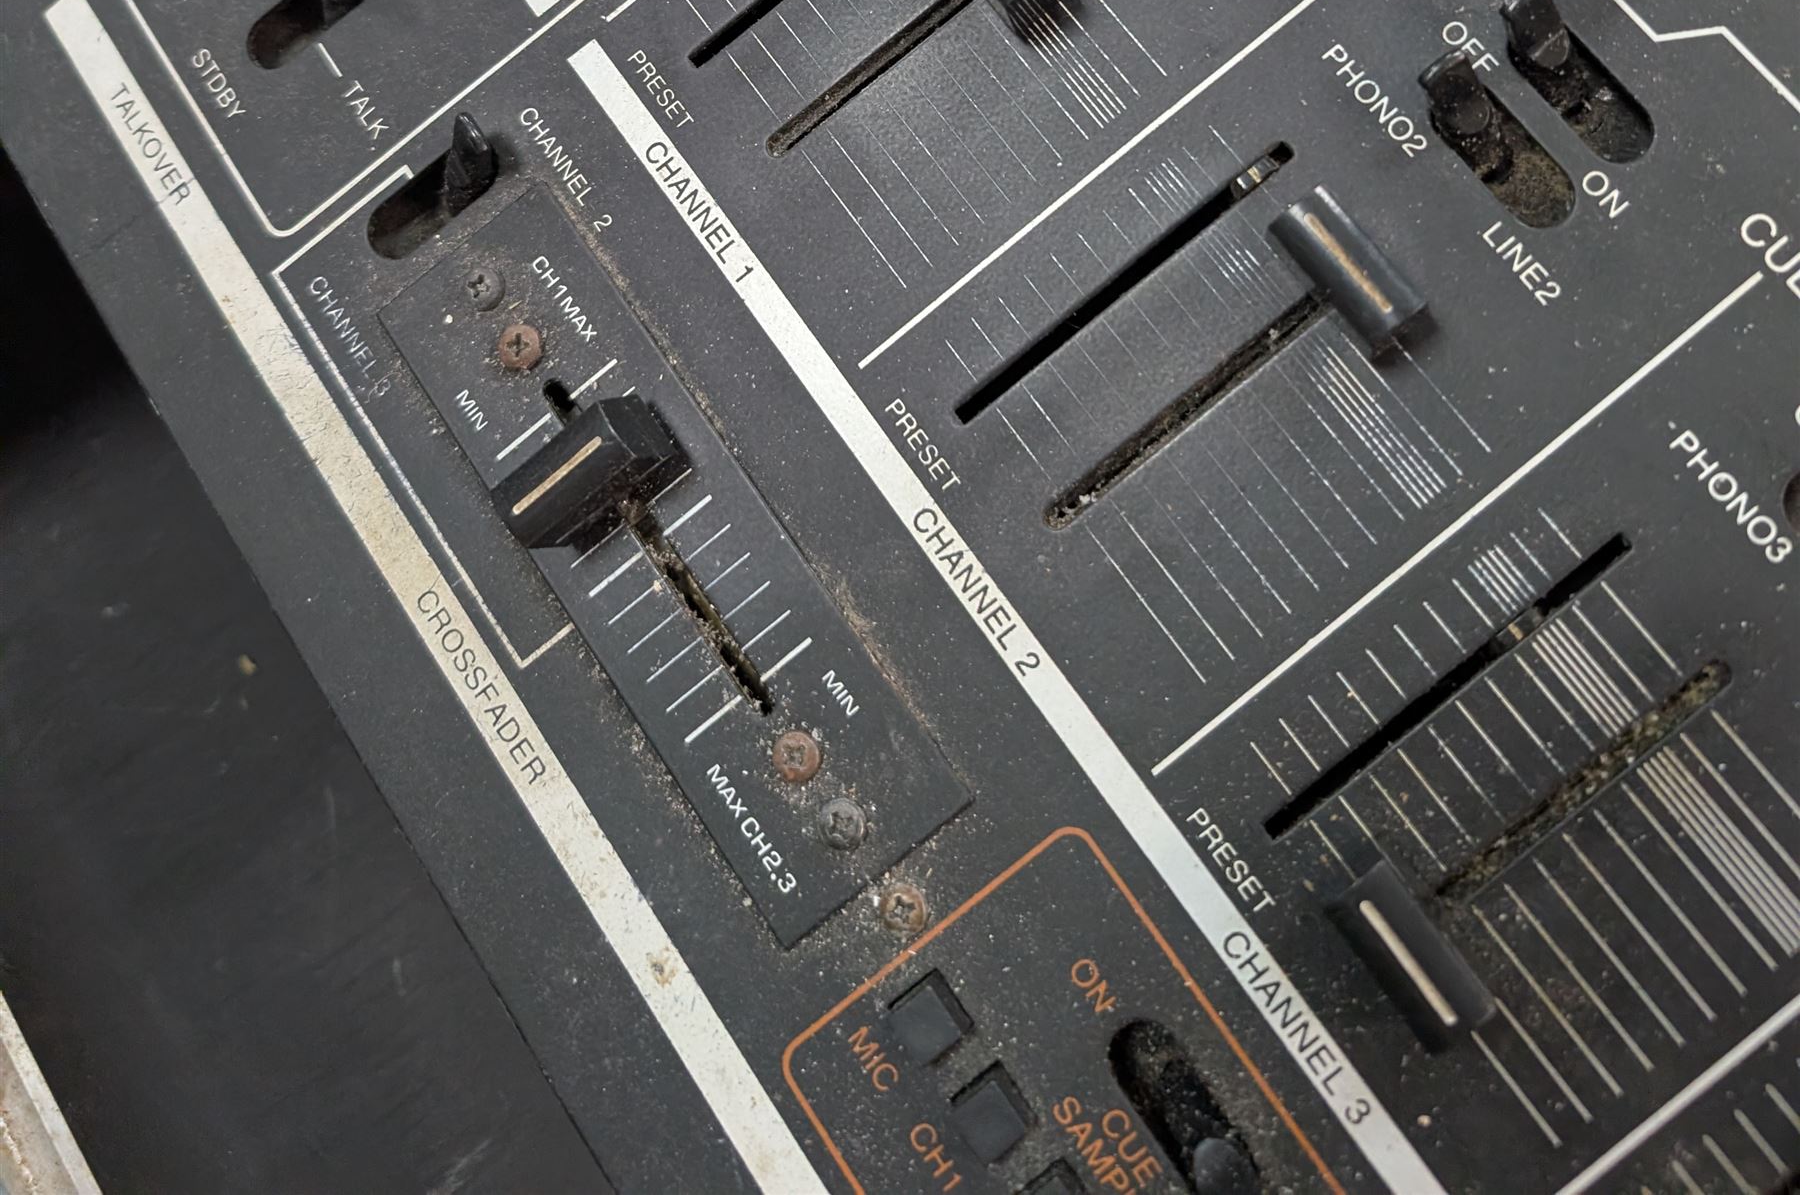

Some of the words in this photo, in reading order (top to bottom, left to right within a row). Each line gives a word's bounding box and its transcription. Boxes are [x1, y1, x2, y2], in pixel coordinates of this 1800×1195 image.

[191, 47, 247, 119] STDBY
[627, 50, 695, 130] PRESET
[1442, 21, 1499, 76] OFF
[109, 82, 191, 206] TALKOVER
[341, 80, 391, 141] TALK
[1321, 43, 1428, 158] PHONO2
[520, 107, 595, 206] CHANNEL
[593, 214, 613, 232] 2
[645, 141, 734, 266] CHANNEL
[735, 265, 756, 285] 1
[1582, 170, 1629, 220] ON
[1482, 220, 1562, 306] LINE2
[309, 276, 377, 377] CHANNEL
[374, 381, 391, 397] 3
[455, 389, 488, 431] MIN
[884, 398, 962, 491] PRESET
[1669, 429, 1793, 564] PHONO3
[912, 508, 1011, 652] CHANNEL
[1014, 652, 1041, 677] 2
[416, 589, 546, 785] CROSSFADER
[821, 669, 860, 717] MIN
[706, 763, 748, 818] MAX
[740, 816, 798, 894] CH2.3
[1186, 807, 1277, 914] PRESET
[1070, 958, 1117, 1014] ON
[1223, 931, 1343, 1096] CHANNEL
[1345, 1099, 1372, 1126] 3
[847, 1026, 899, 1092] MIC
[910, 1122, 962, 1192] CH1
[1053, 1096, 1137, 1195] SAMP
[1102, 1109, 1164, 1188] CUE
